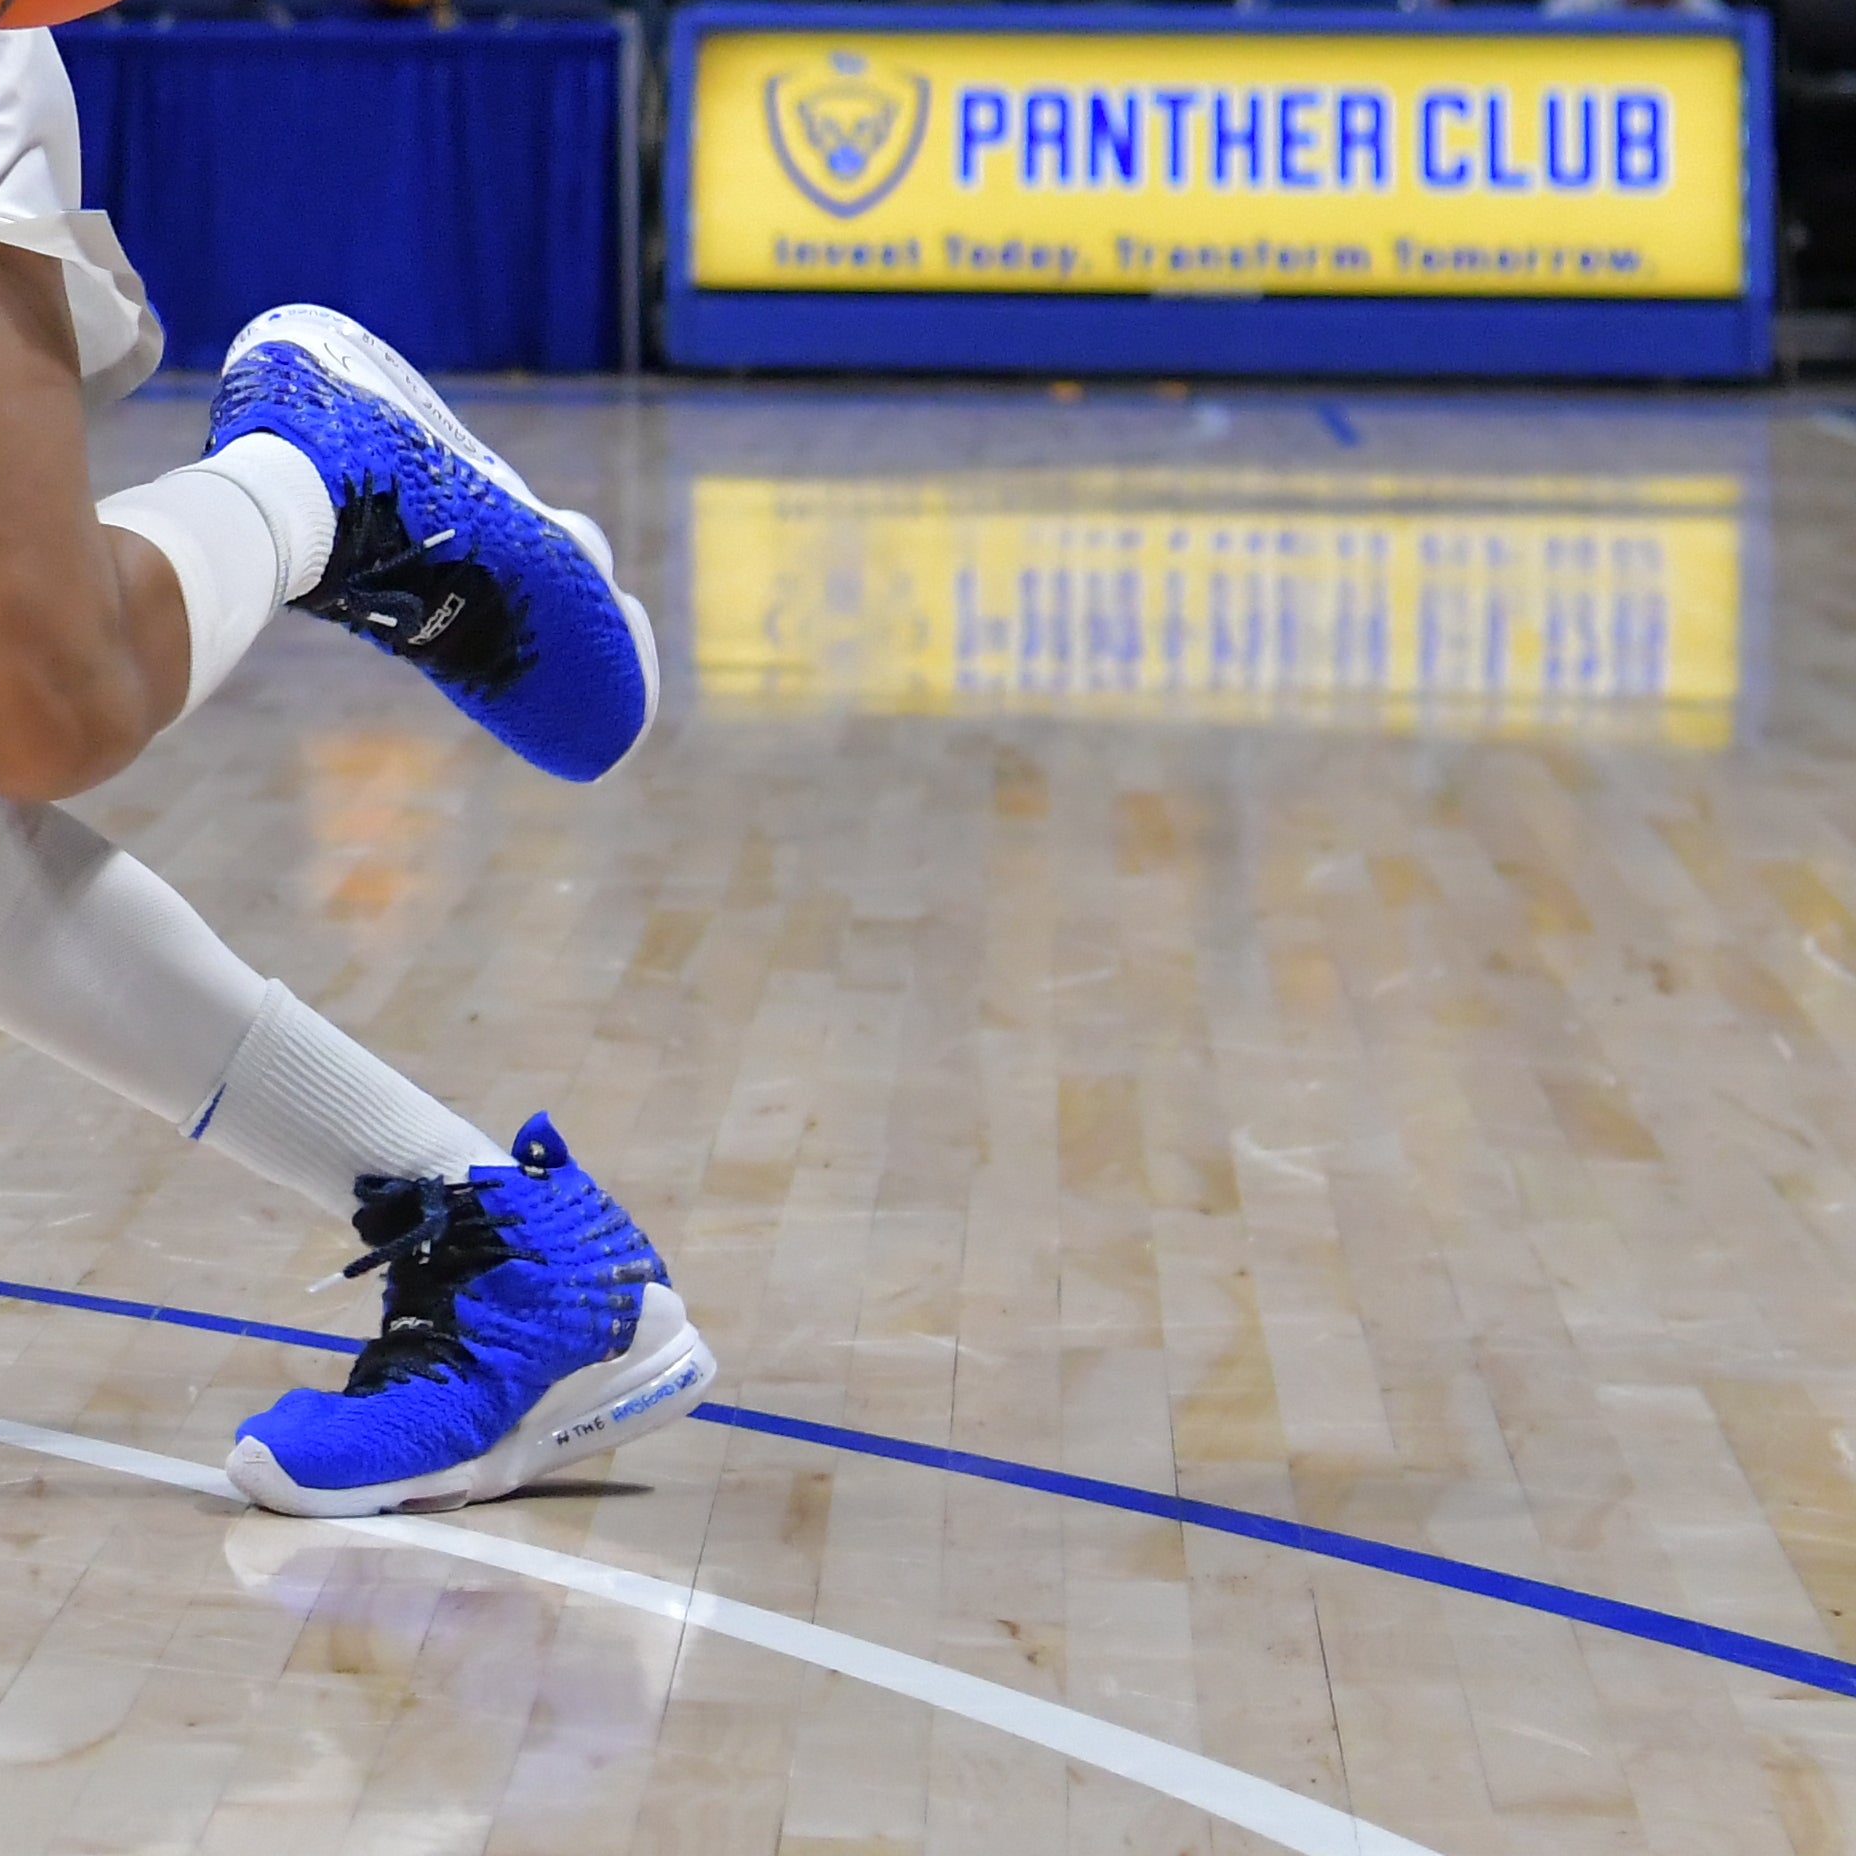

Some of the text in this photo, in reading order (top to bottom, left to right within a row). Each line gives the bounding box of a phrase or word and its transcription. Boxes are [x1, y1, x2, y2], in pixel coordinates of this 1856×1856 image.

[959, 88, 1664, 188] PANTHER CLUB
[775, 235, 920, 268] Invest
[1116, 235, 1371, 272] Transform
